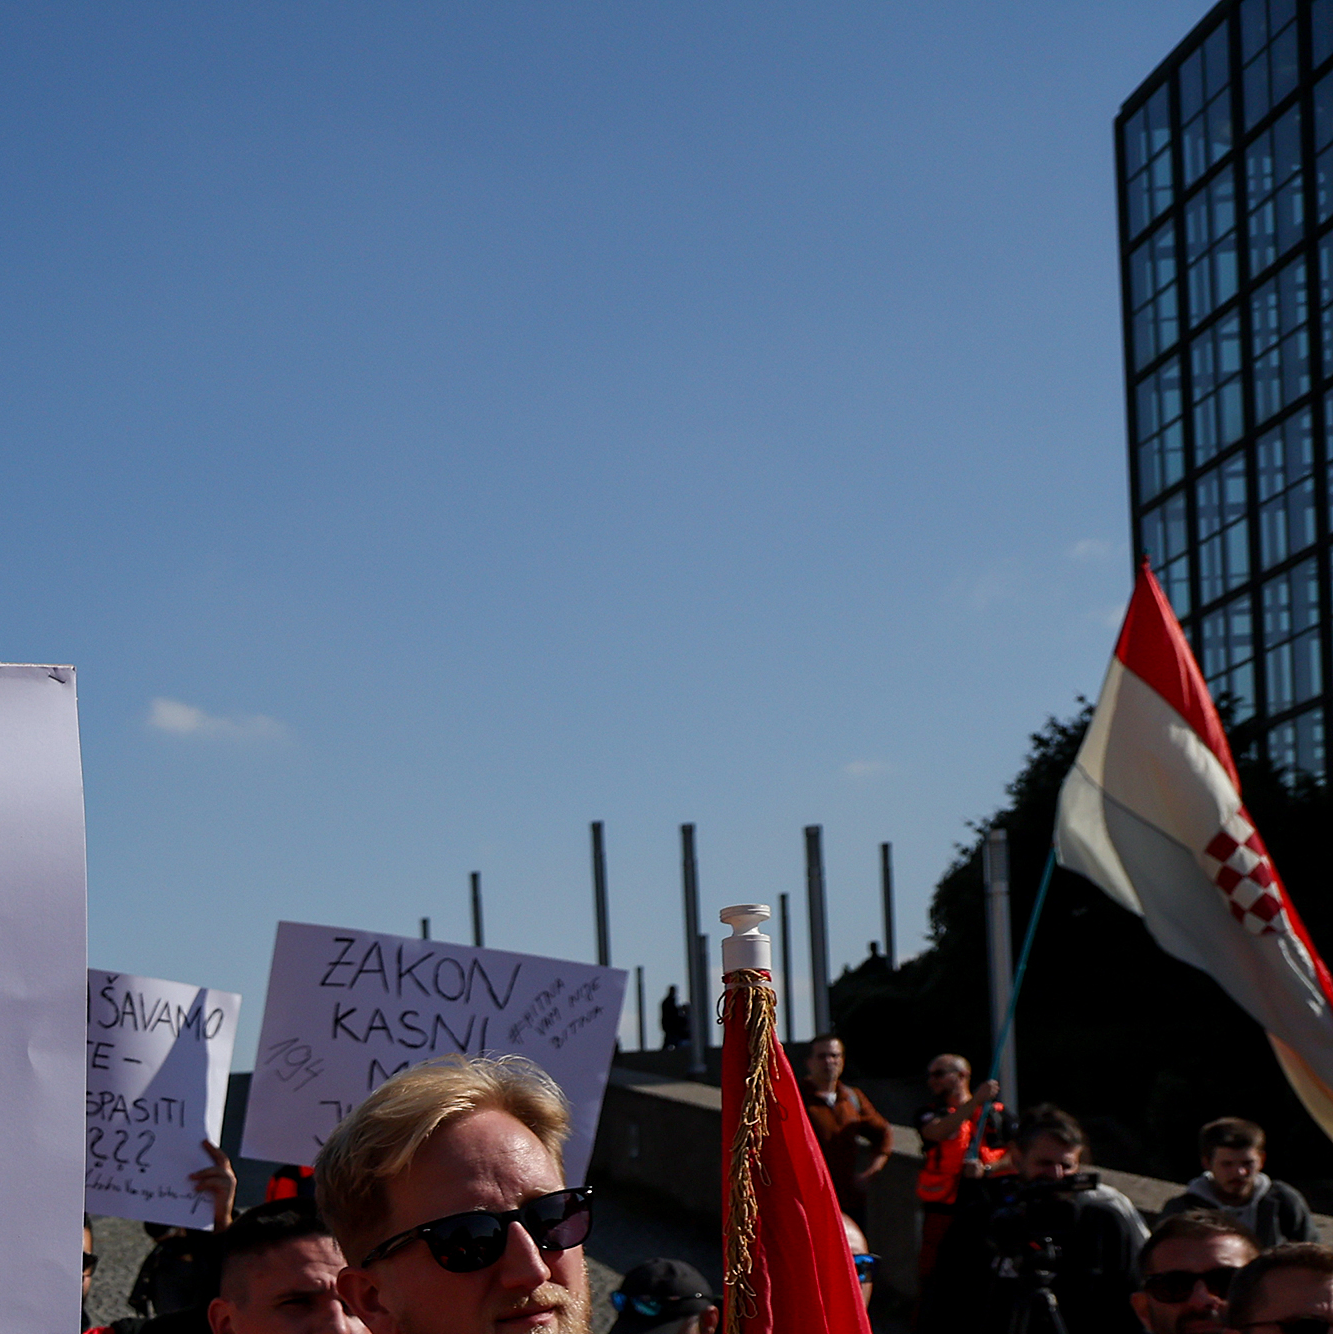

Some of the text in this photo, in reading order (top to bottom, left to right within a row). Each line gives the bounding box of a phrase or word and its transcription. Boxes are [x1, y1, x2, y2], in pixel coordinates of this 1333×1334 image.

[319, 937, 521, 1010] ZAKON
[87, 974, 224, 1042] ŠAVAMO
[333, 1002, 489, 1057] KASNI
[265, 1036, 325, 1092] 194
